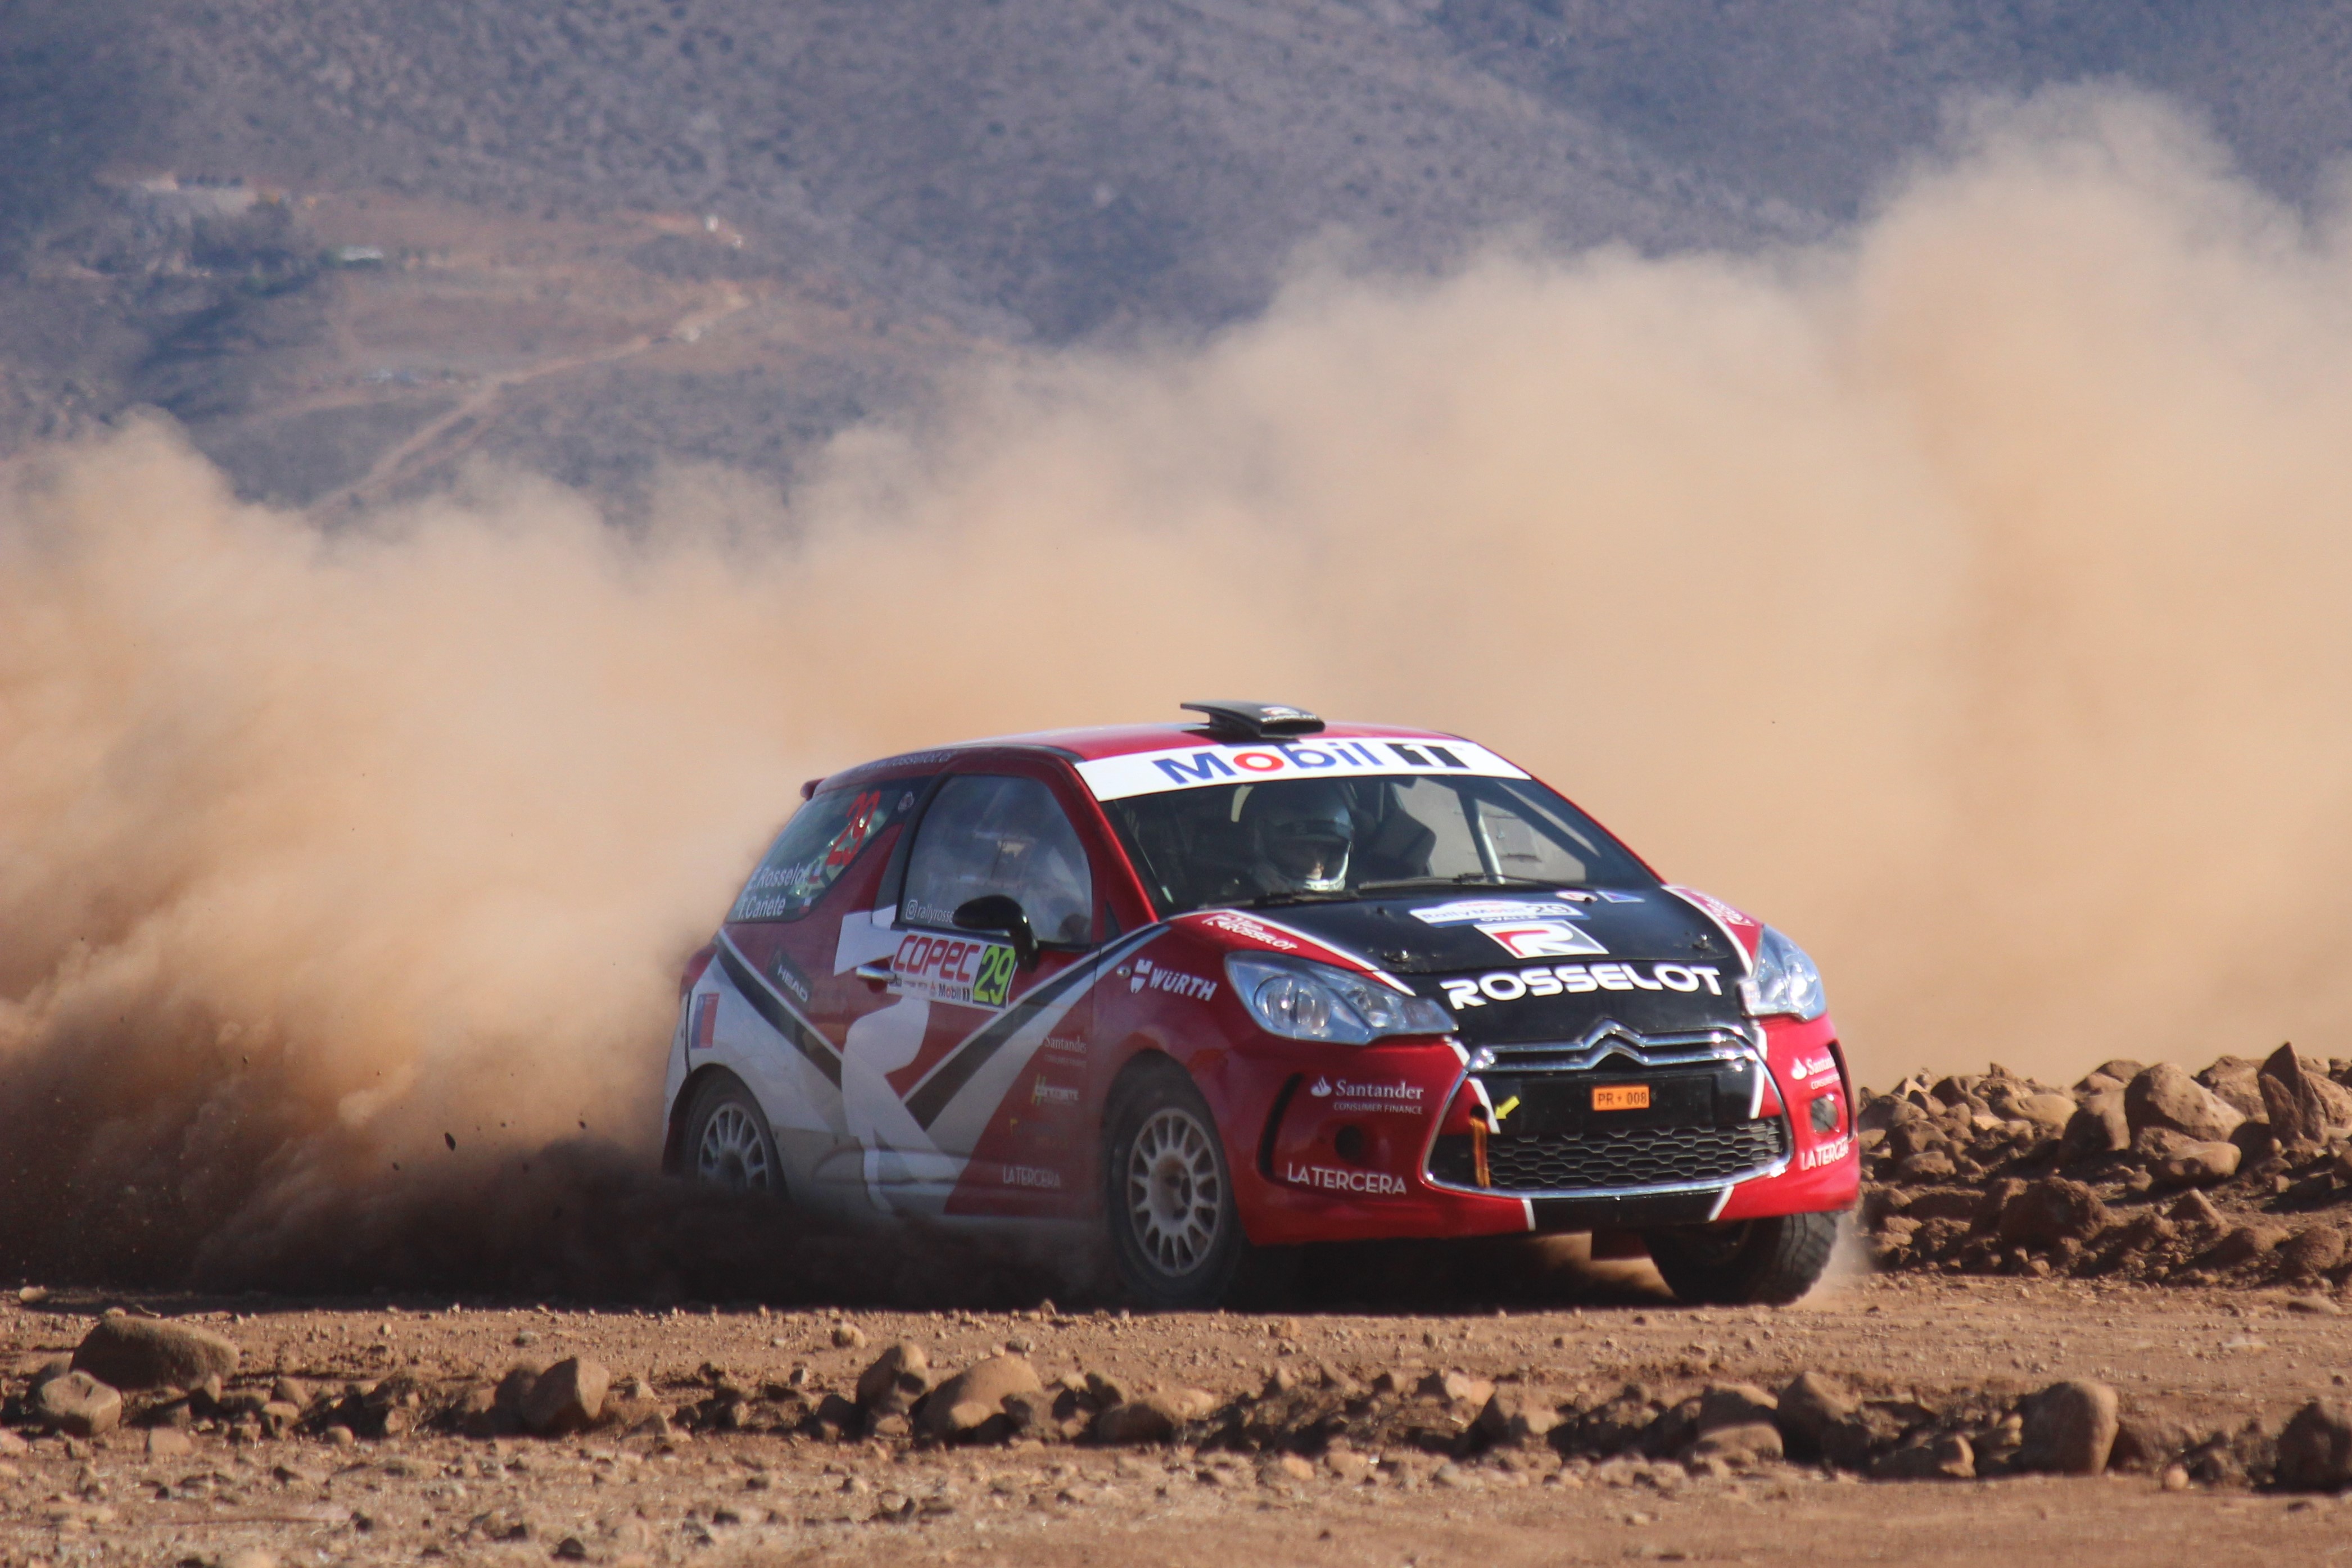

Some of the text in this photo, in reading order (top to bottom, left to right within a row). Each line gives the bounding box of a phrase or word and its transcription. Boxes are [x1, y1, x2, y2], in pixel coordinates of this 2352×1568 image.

[1151, 742, 1385, 785] Mobil
[825, 791, 881, 866] 29
[917, 904, 955, 924] rallyrosse
[973, 945, 1016, 1005] 29
[1149, 967, 1218, 1002] WÜRTH
[1439, 963, 1723, 1010] ROSSELOT
[1335, 1079, 1424, 1100] Santander
[1598, 1091, 1648, 1106] PR 008
[1332, 1102, 1423, 1115] CONSUMER FINANCE
